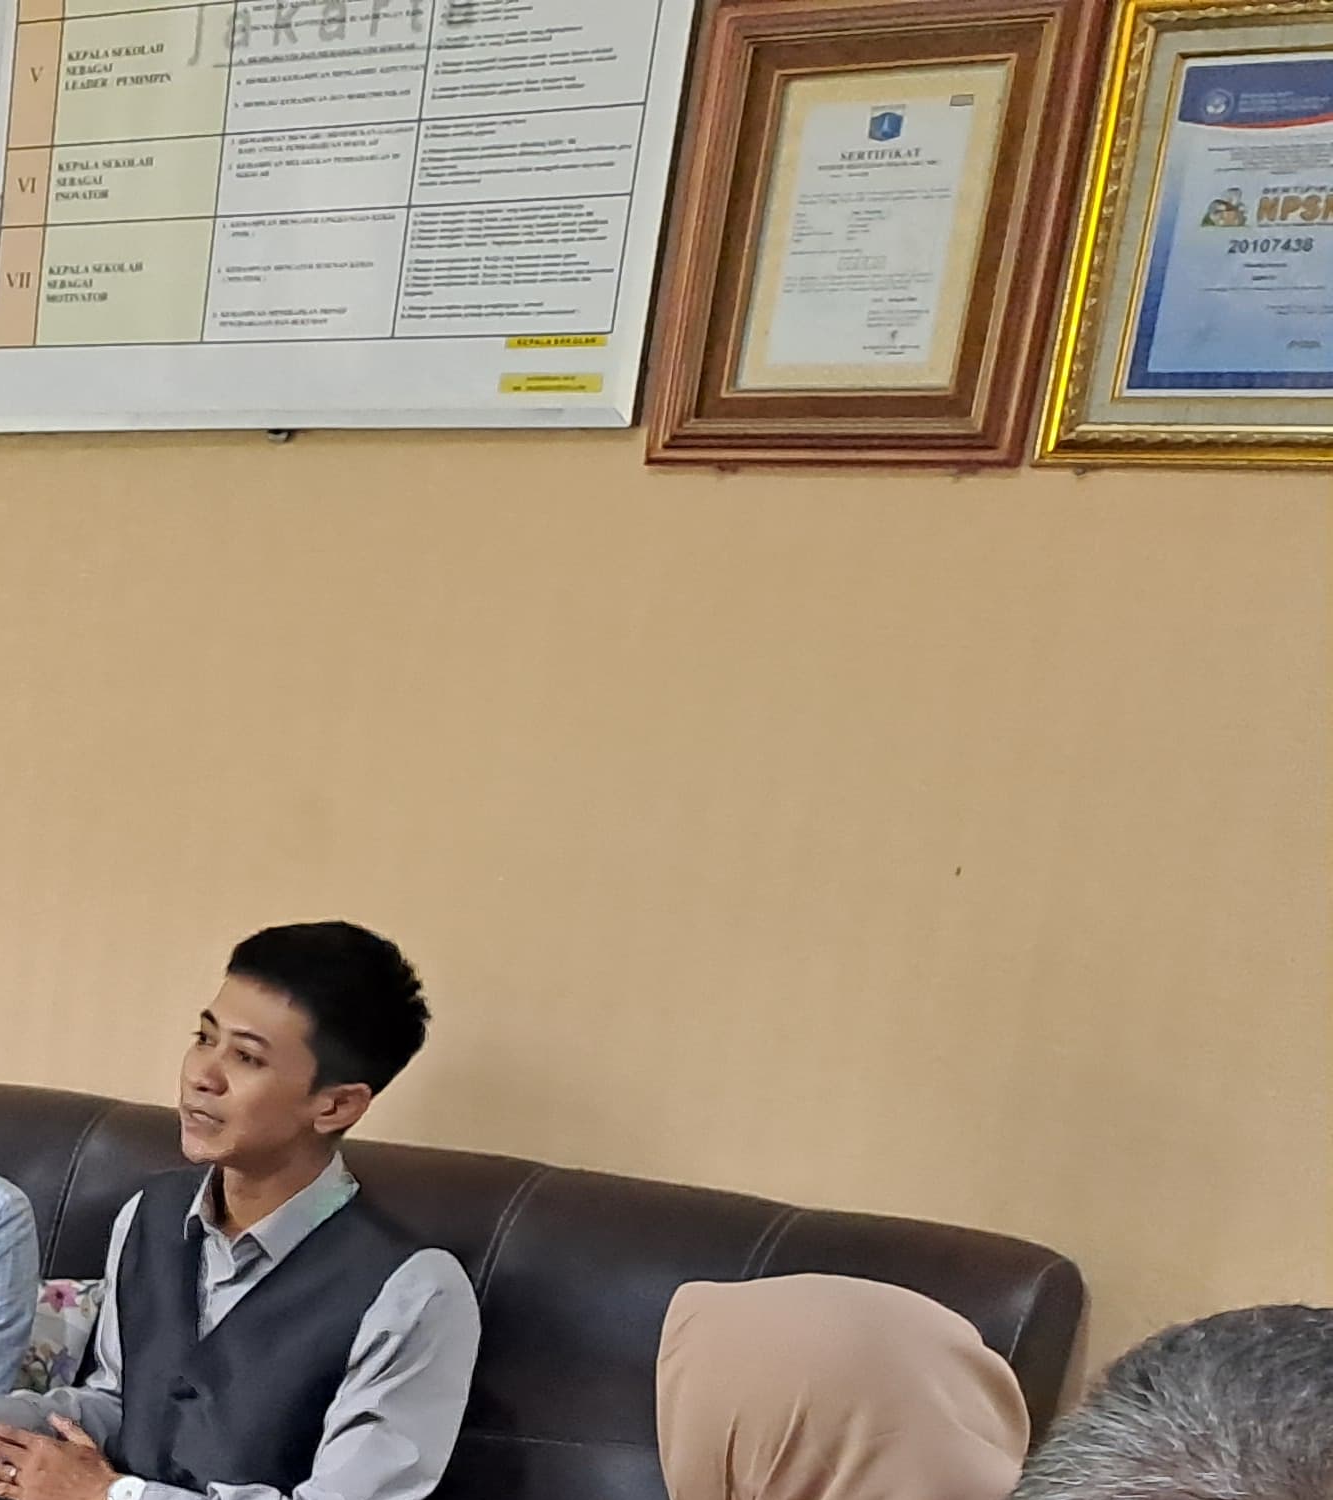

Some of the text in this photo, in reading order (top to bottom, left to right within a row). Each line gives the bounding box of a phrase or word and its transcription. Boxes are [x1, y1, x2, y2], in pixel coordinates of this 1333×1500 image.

[67, 43, 165, 62] KEPALA SEKOLAH
[30, 66, 44, 83] V
[839, 148, 922, 161] SERTIFIKAT
[57, 157, 154, 172] KEPALA SEKOLAH
[17, 177, 37, 194] VI
[1227, 237, 1314, 254] 20107438
[48, 261, 144, 276] KEPALA SEKOLAH
[6, 272, 31, 289] VII
